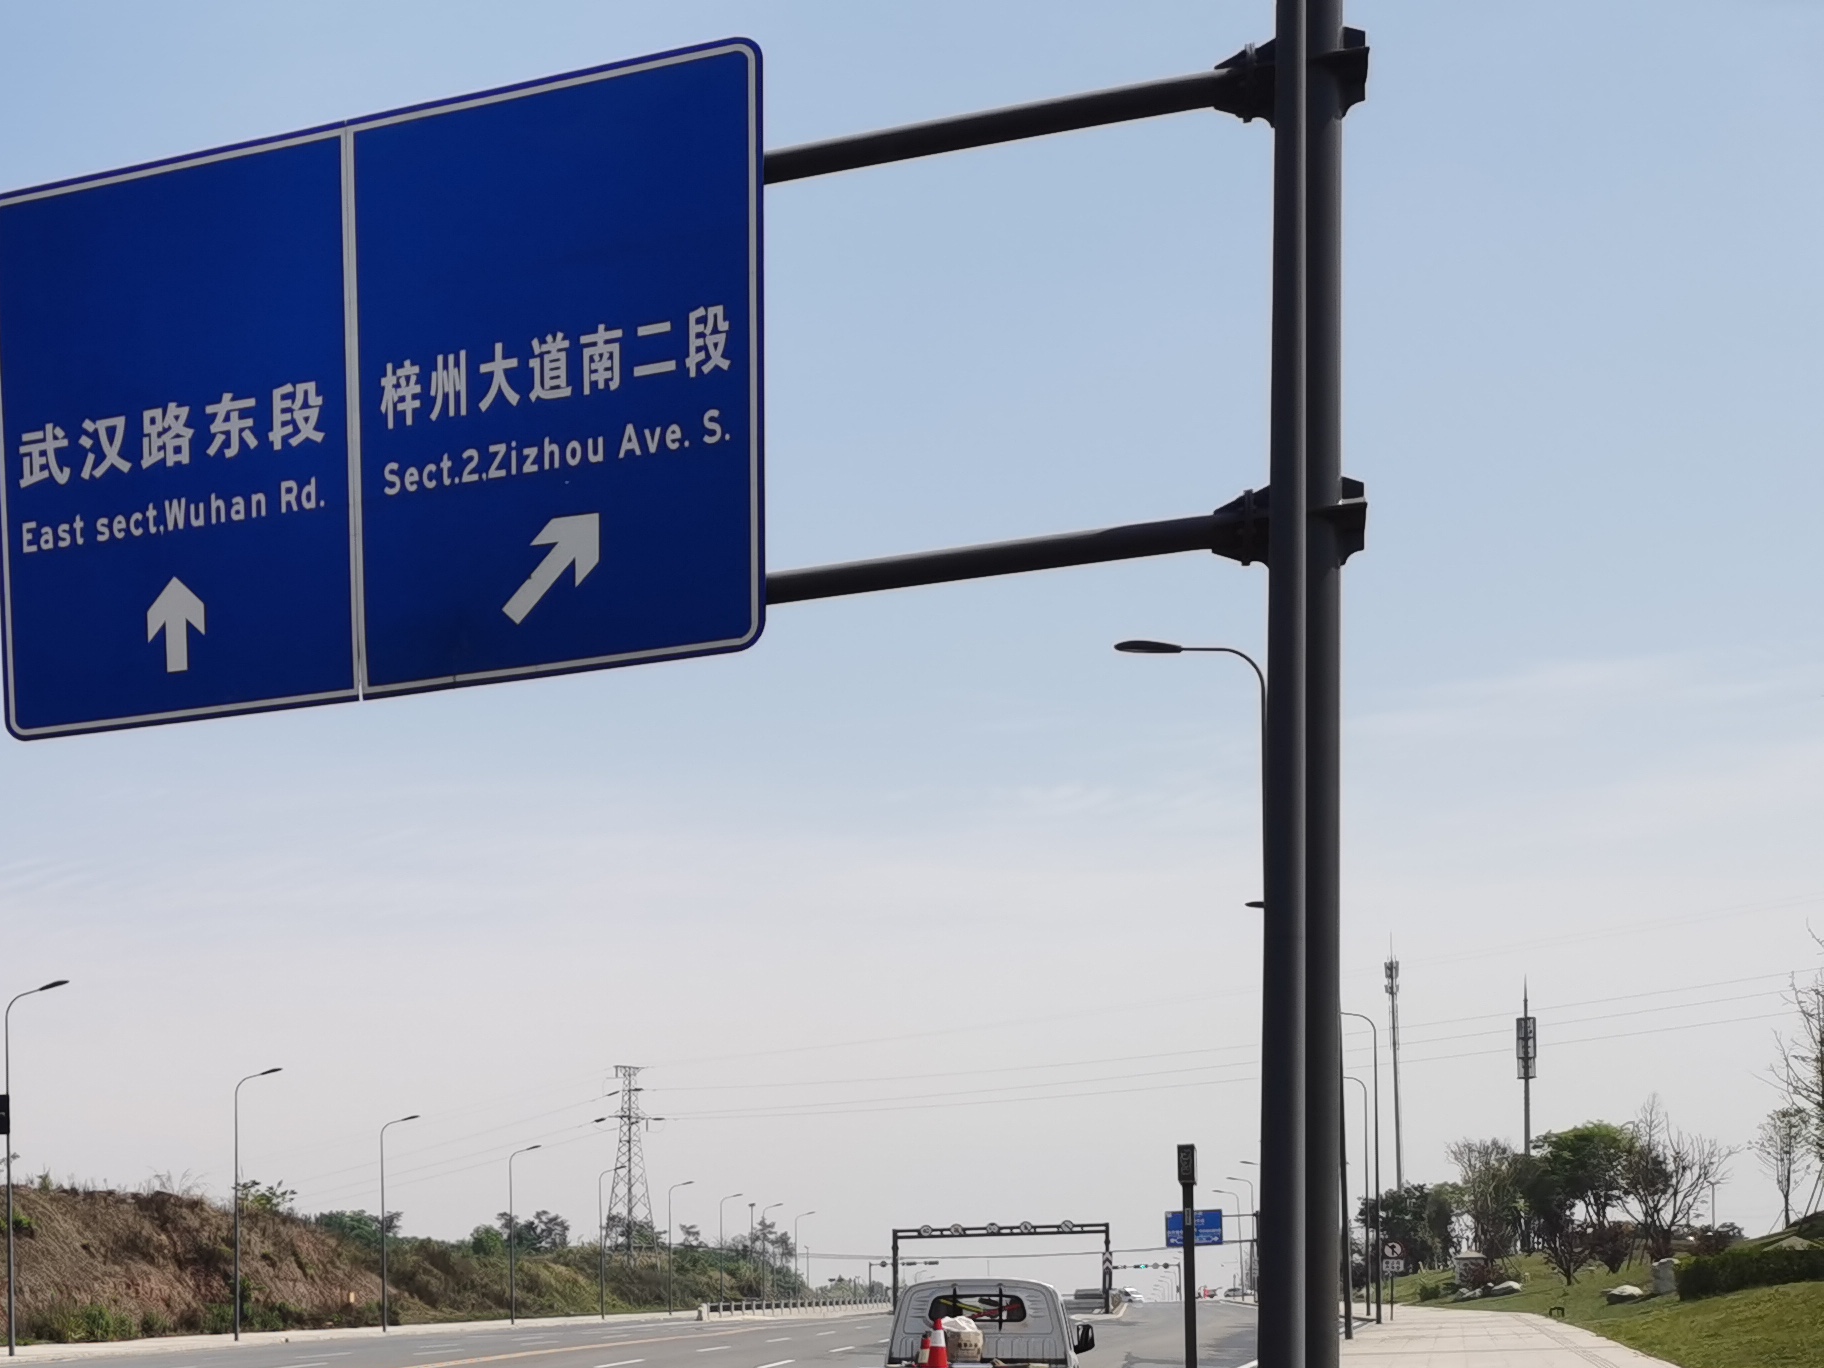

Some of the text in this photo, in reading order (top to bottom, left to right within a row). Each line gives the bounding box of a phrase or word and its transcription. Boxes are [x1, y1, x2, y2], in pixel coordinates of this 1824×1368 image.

[380, 304, 731, 430] 梓州大道南二段
[19, 381, 326, 488] 武汉路东段
[618, 422, 690, 459] Ave.
[702, 408, 731, 444] S.
[22, 514, 84, 553] East
[280, 476, 325, 513] Rd.
